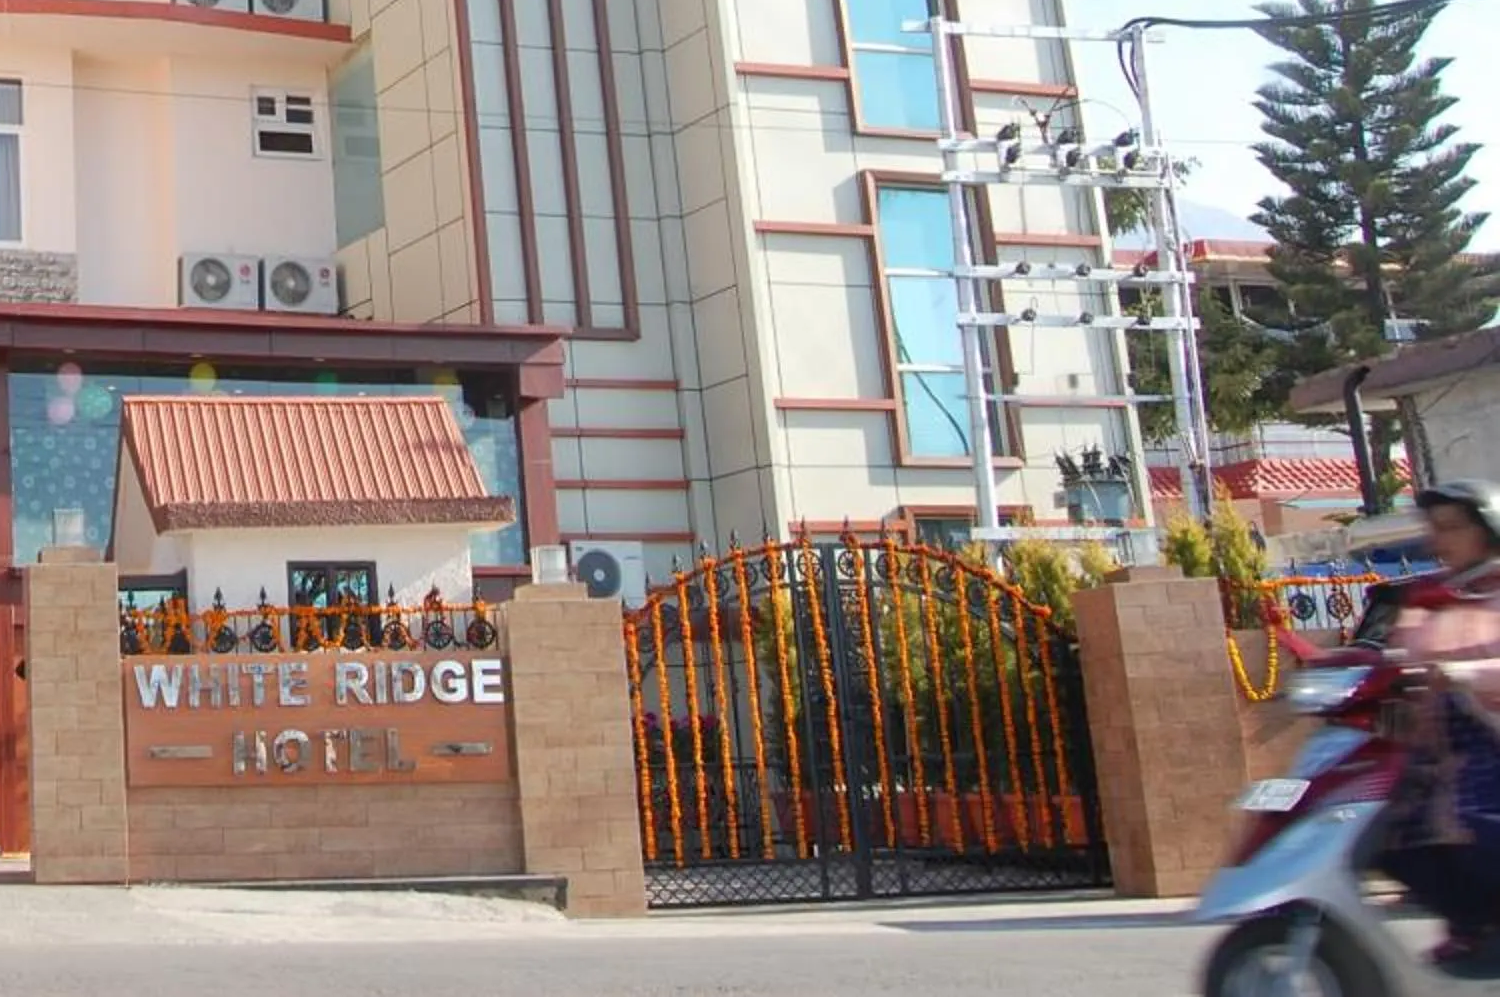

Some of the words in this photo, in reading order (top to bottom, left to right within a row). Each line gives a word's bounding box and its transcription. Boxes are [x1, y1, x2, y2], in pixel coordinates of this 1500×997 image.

[133, 662, 311, 709] WHITE
[335, 658, 505, 706] RIDGE
[232, 727, 417, 775] HOTEL
